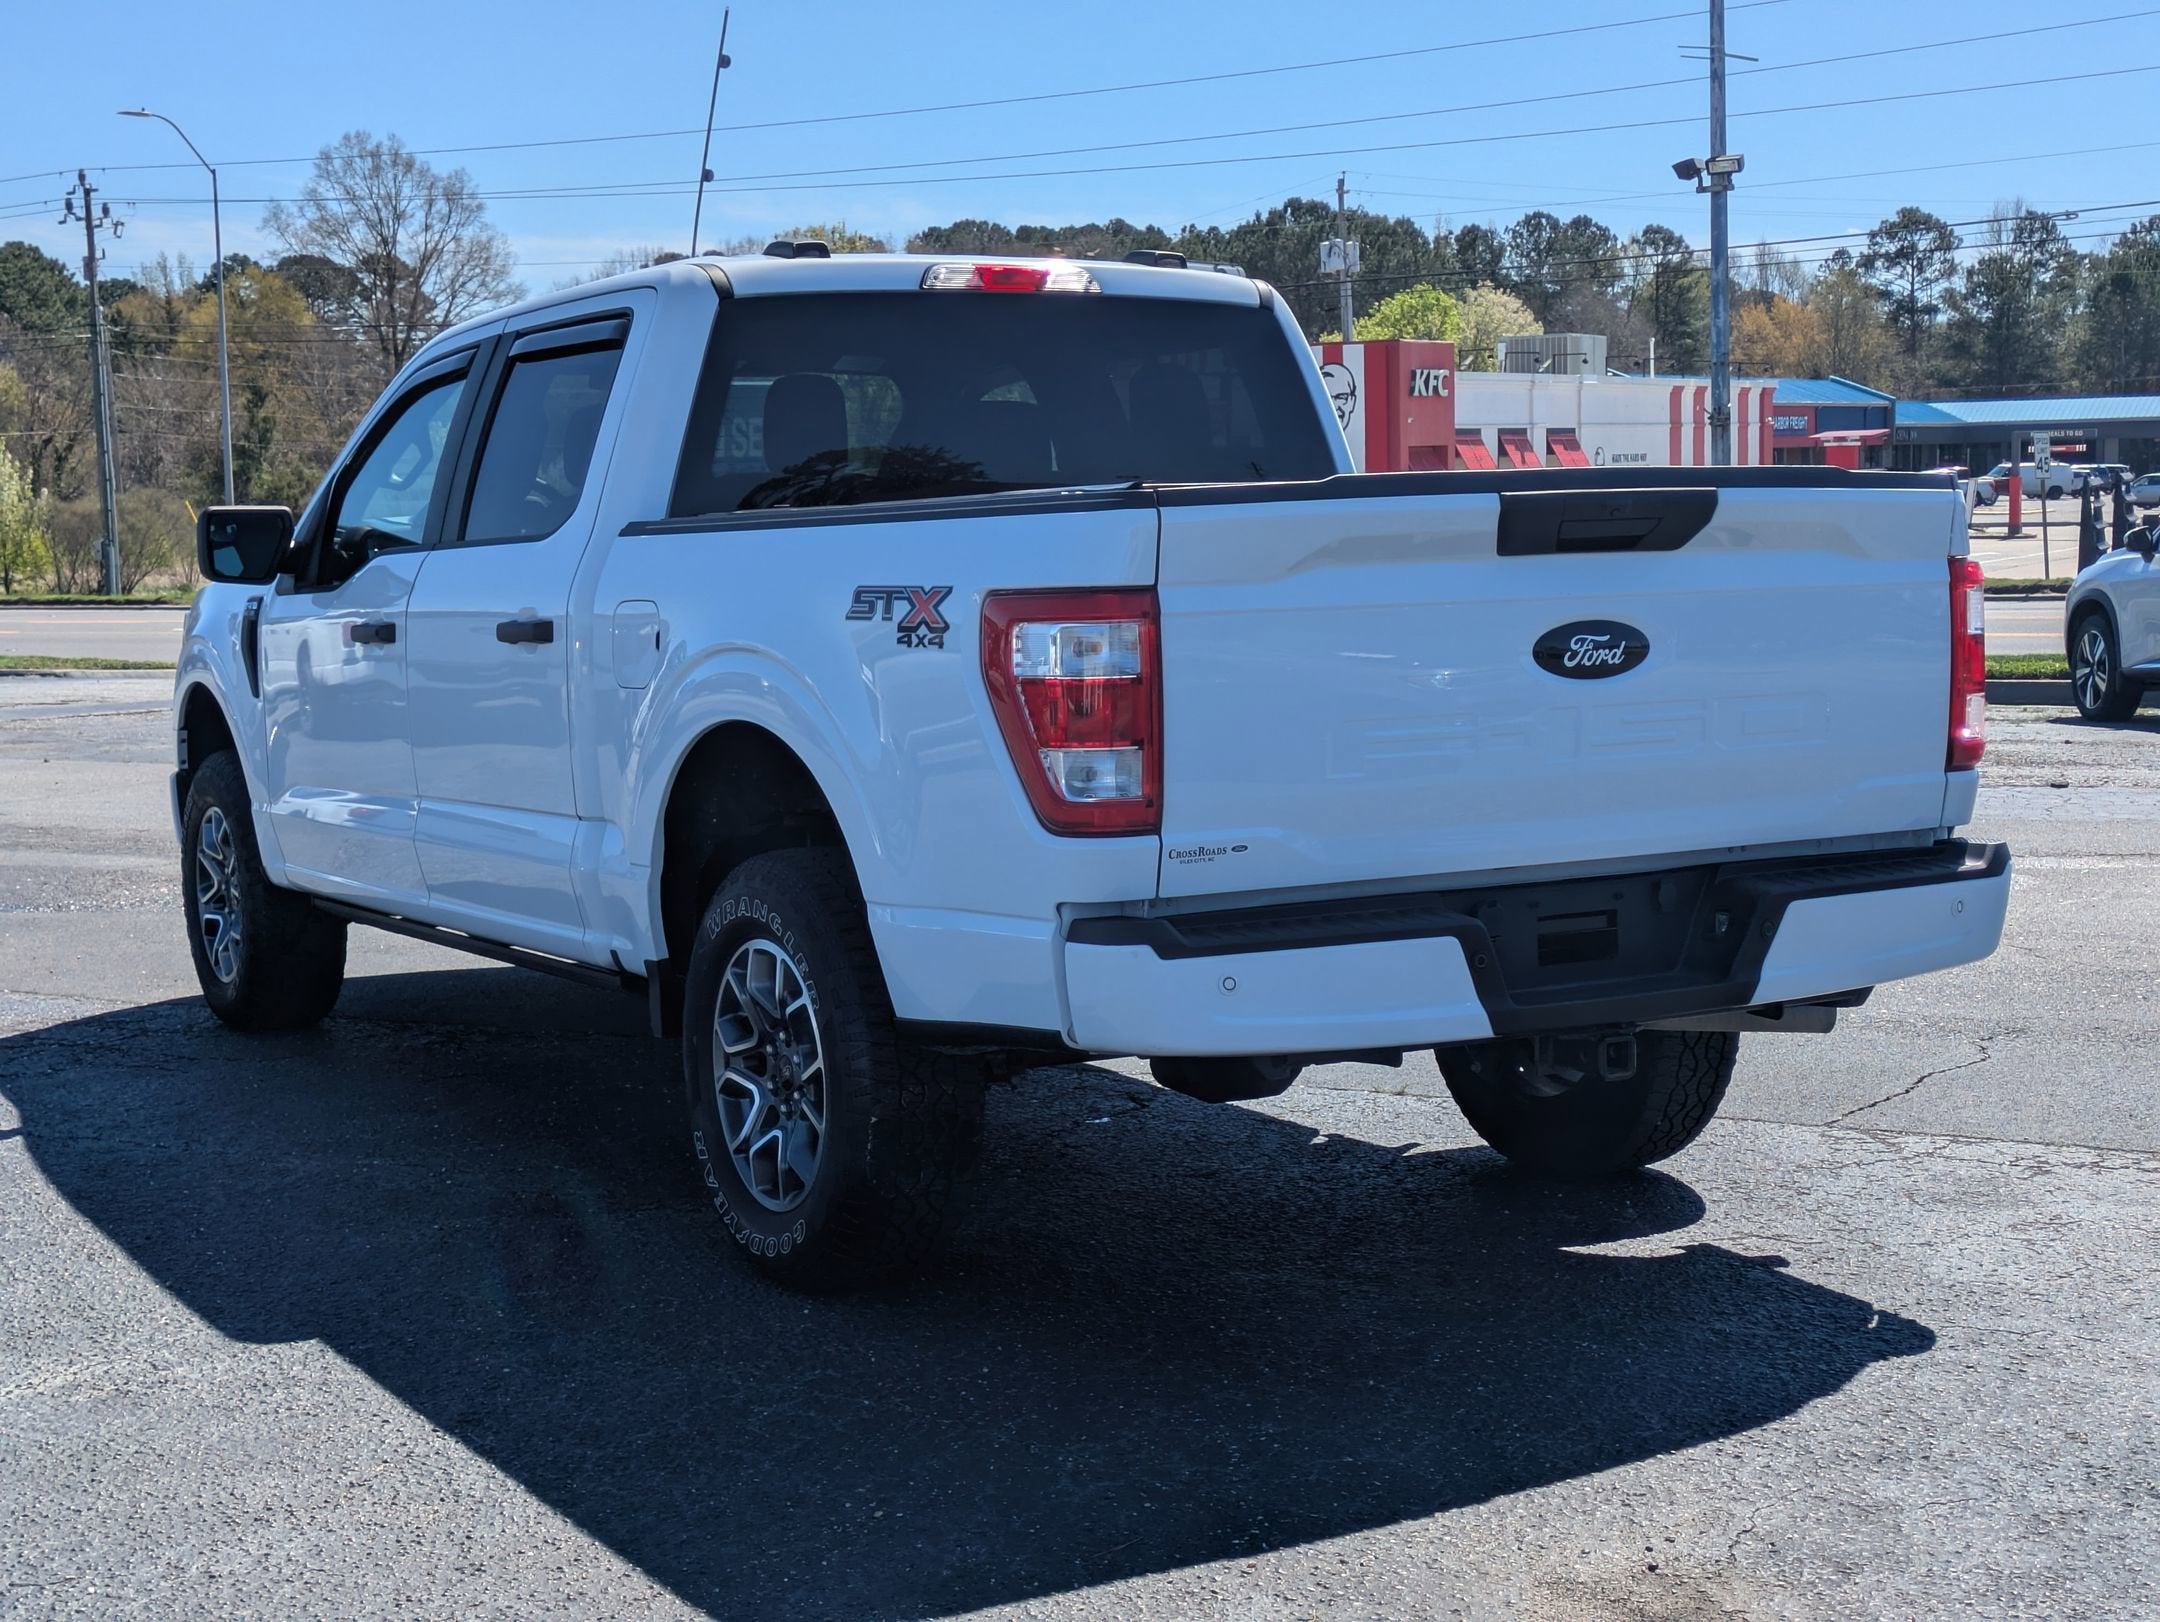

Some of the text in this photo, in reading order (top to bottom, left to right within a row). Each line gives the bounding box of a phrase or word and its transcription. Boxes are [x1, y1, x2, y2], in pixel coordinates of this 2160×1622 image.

[1412, 368, 1449, 397] KFC
[2036, 456, 2050, 473] 45
[845, 585, 953, 634] STX
[1563, 634, 1626, 668] Ford
[706, 896, 820, 1010] WRANGLER
[693, 1128, 807, 1258] GOODYEAR
